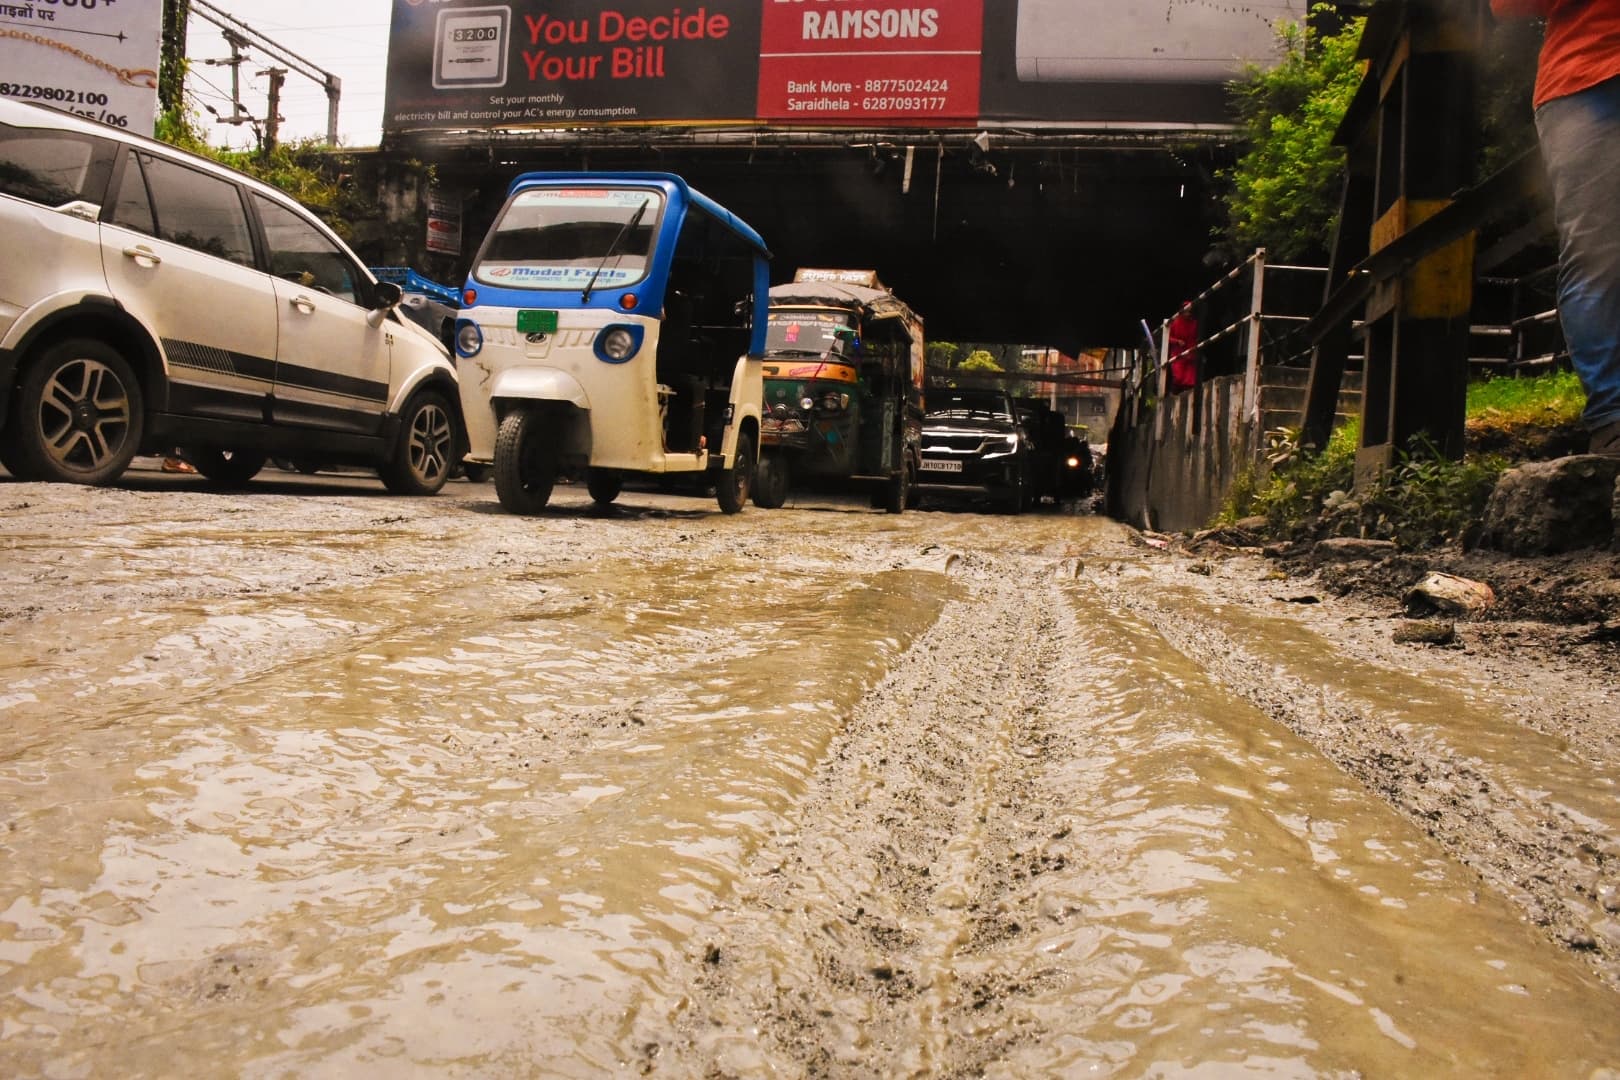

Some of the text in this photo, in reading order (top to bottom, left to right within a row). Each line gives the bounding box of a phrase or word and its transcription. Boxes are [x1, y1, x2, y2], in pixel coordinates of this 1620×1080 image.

[37, 9, 56, 21] पर
[524, 8, 730, 45] You Decide
[802, 9, 938, 40] RAMSONS
[455, 28, 495, 41] 3200
[521, 46, 665, 81] Your Bill
[787, 81, 817, 93] Bank
[820, 81, 852, 93] More
[864, 79, 948, 92] 8877502424
[0, 83, 108, 106] 8229802100
[489, 93, 565, 106] Set your monthly
[787, 97, 850, 111] Saraidhela
[862, 97, 946, 110] 6287093177
[394, 112, 436, 122] electricity
[438, 110, 451, 120] bill
[452, 110, 469, 120] and
[470, 109, 501, 119] control
[502, 108, 521, 120] your
[523, 108, 544, 117] AC's
[546, 108, 576, 118] energy
[511, 267, 627, 278] Model Fuels
